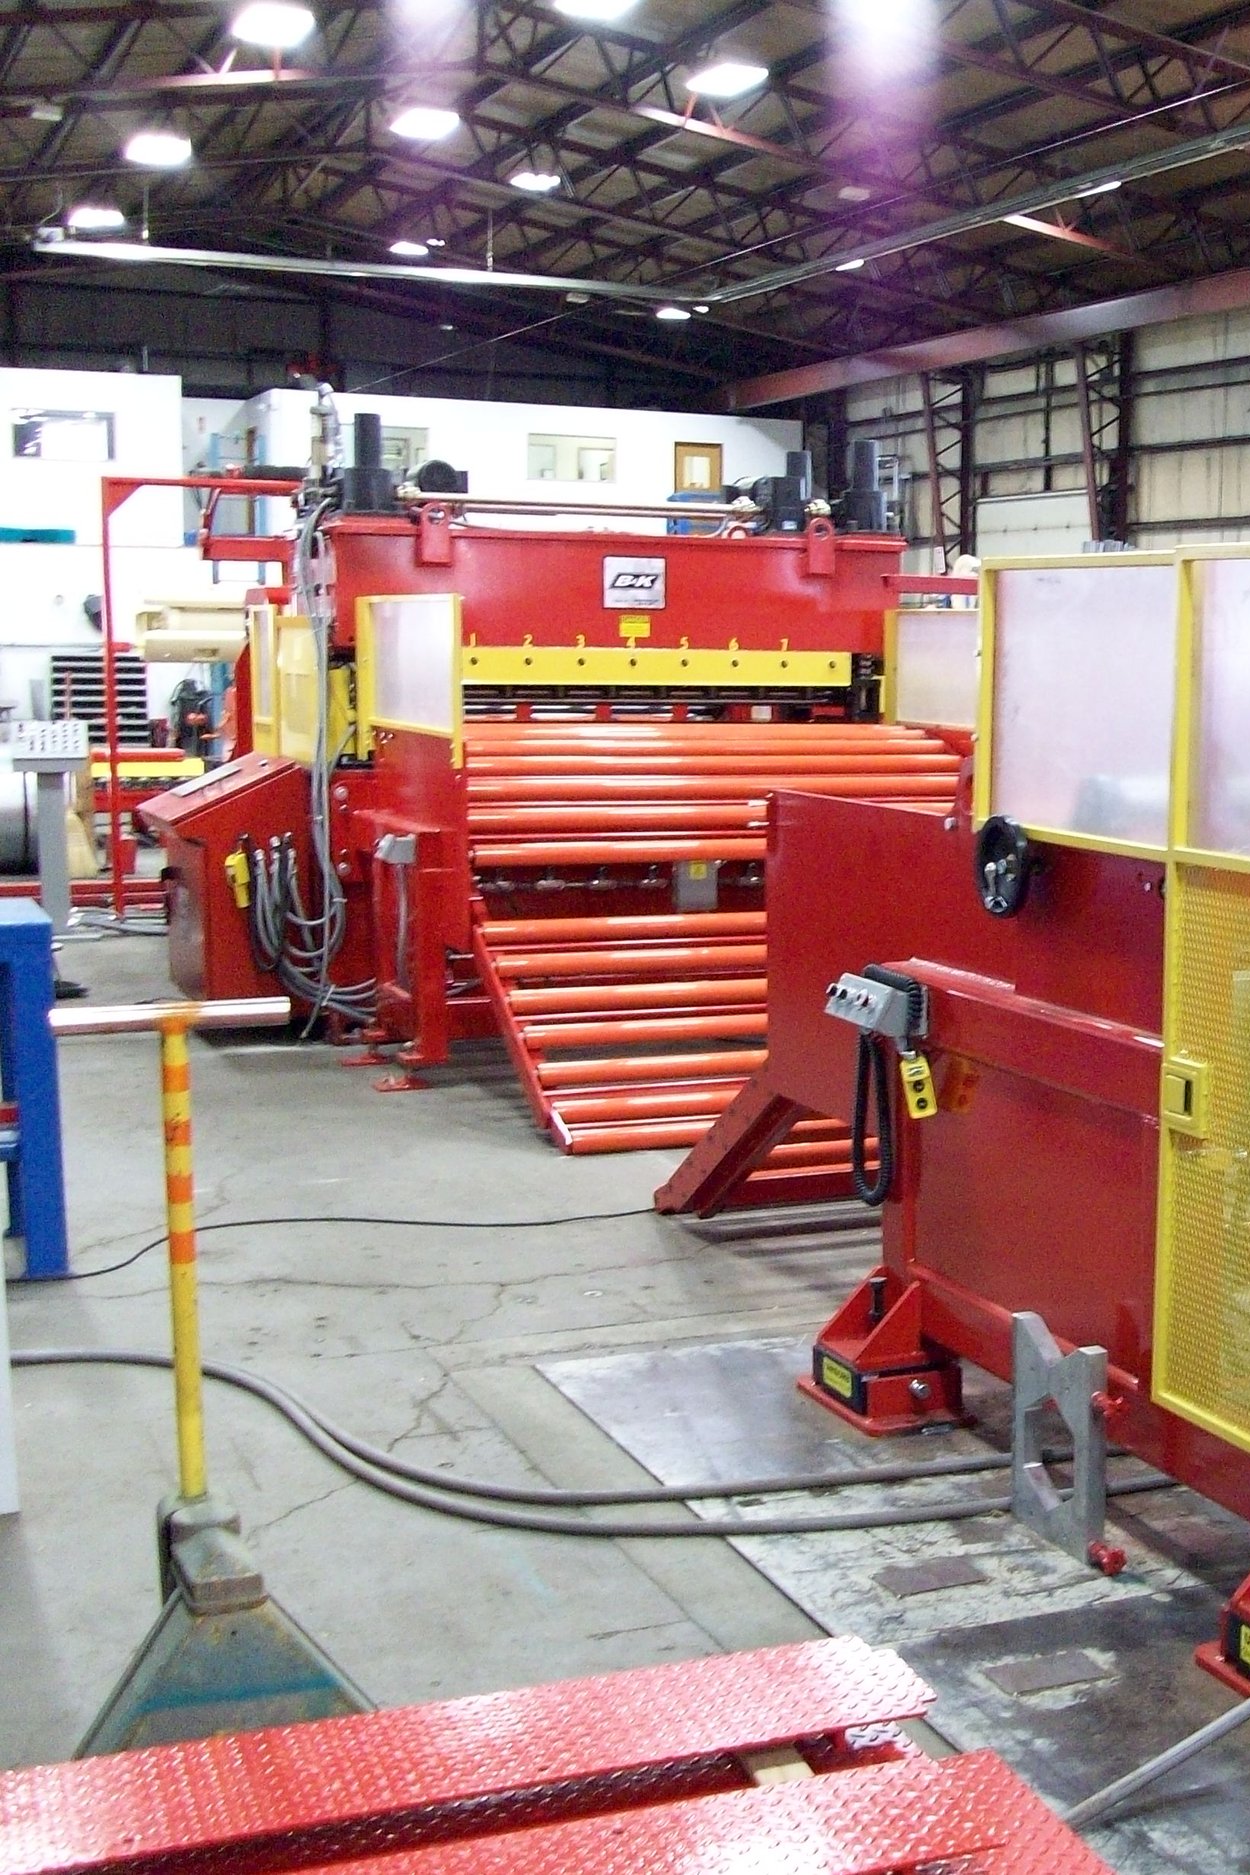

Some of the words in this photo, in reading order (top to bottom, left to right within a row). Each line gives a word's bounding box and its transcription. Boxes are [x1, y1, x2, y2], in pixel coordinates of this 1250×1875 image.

[468, 632, 477, 647] 1
[522, 633, 534, 648] 2
[575, 634, 586, 648] 3
[626, 636, 636, 649] 4
[679, 636, 689, 650] 5
[728, 637, 739, 651] 6
